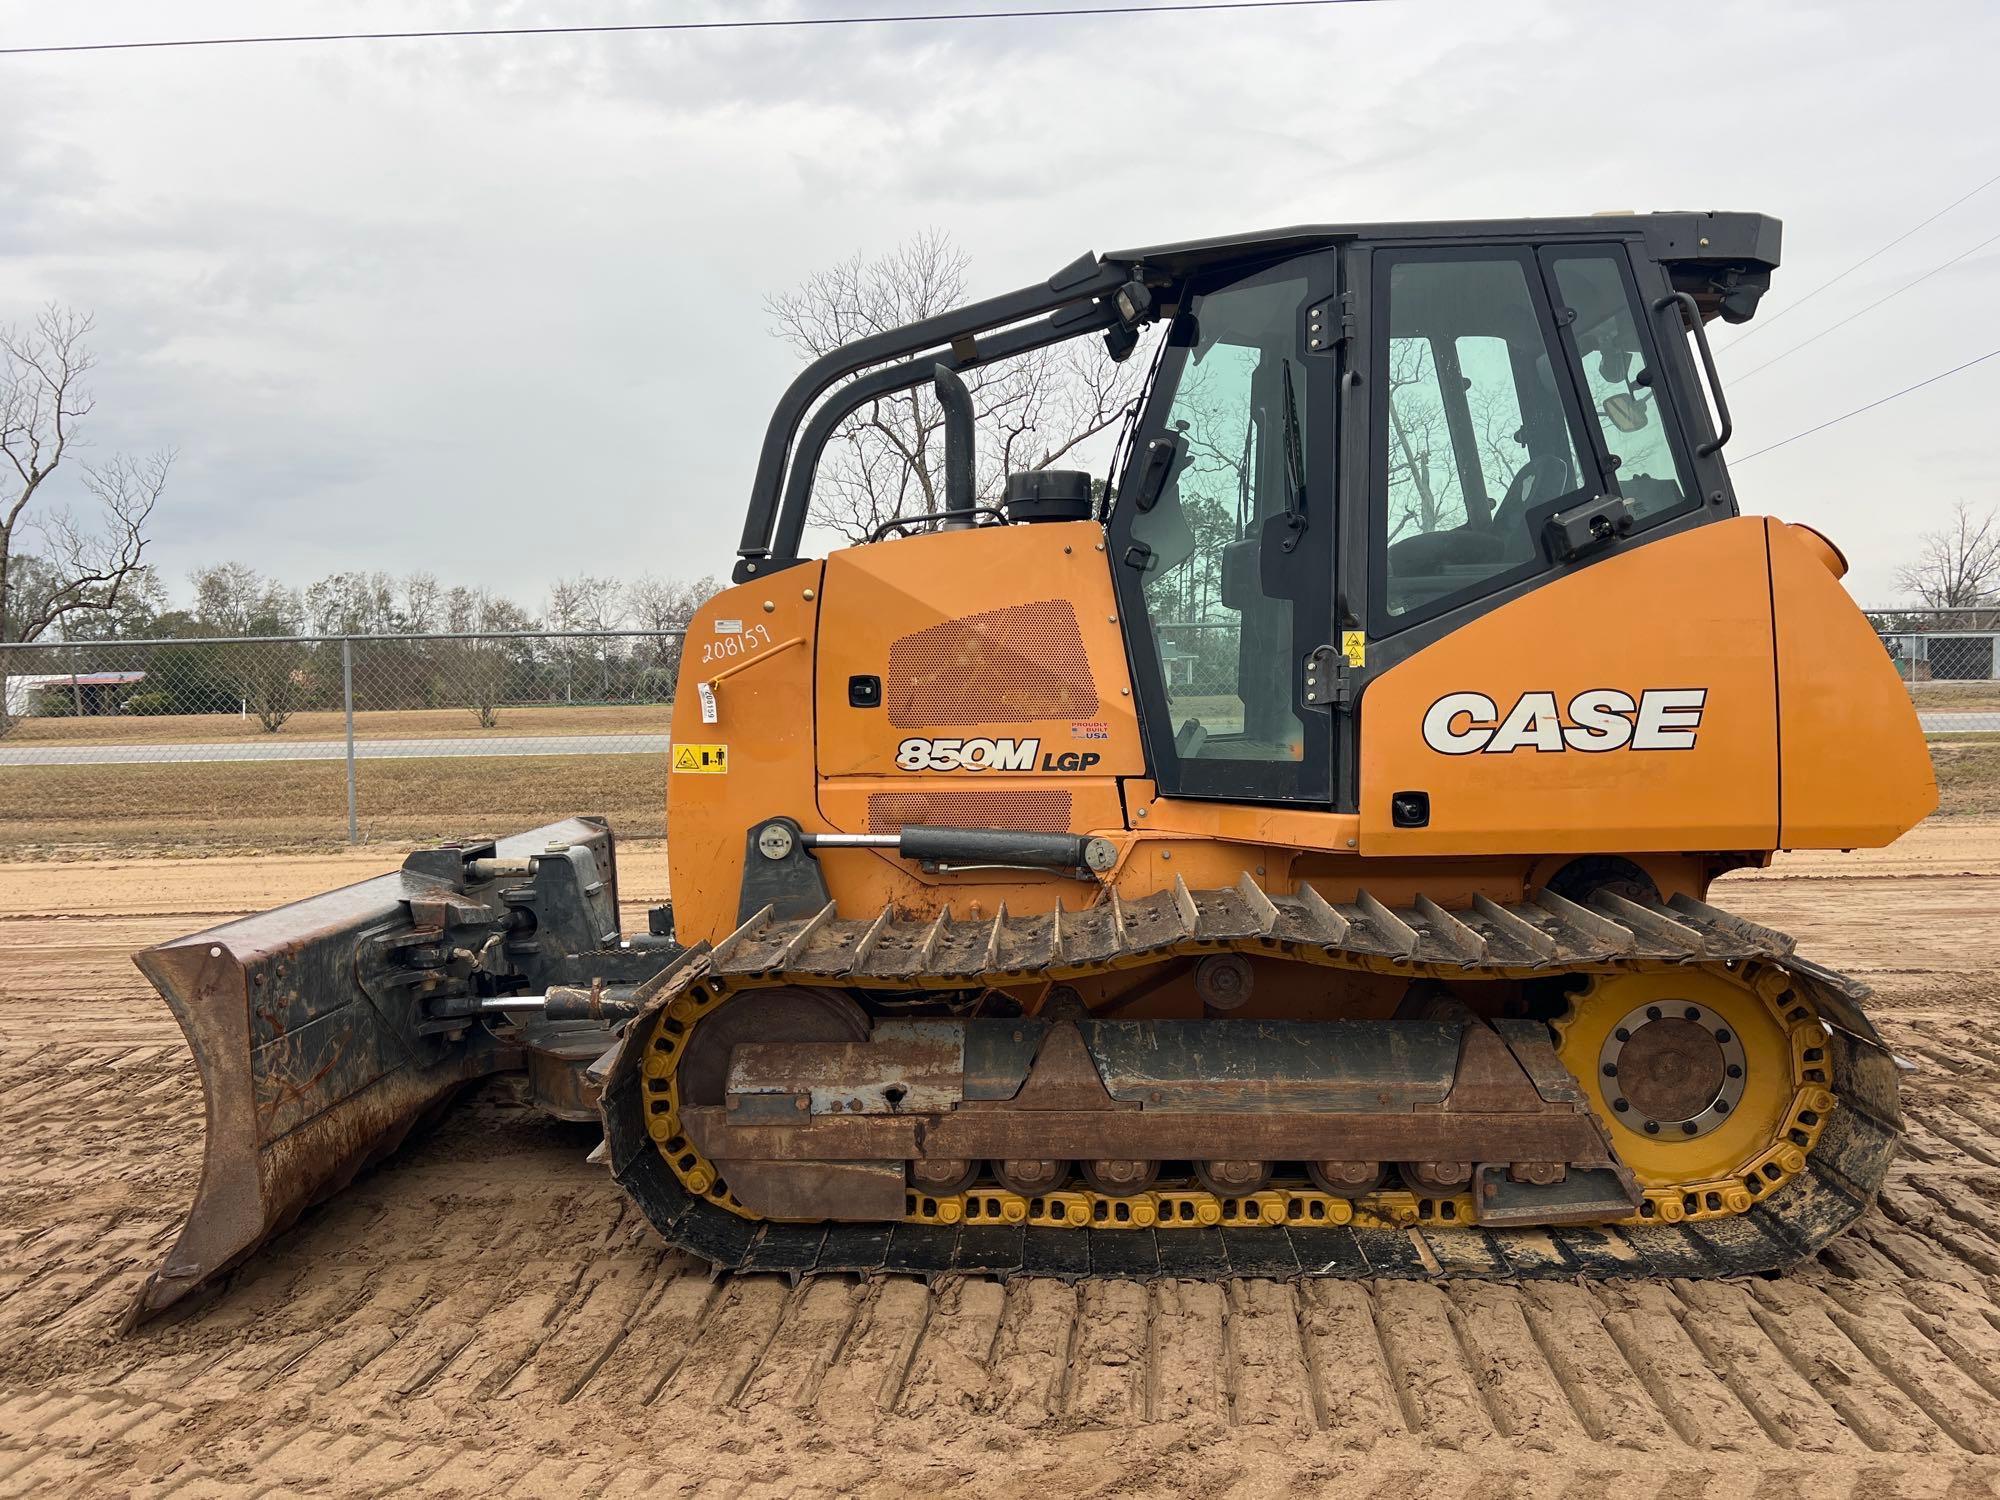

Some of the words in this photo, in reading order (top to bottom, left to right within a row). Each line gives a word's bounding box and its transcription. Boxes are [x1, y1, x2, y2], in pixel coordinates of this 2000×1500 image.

[702, 624, 771, 664] 208159
[704, 691, 715, 719] 208159
[1422, 688, 1708, 755] CASE
[895, 738, 1041, 772] 850M
[1042, 753, 1101, 772] LGP
